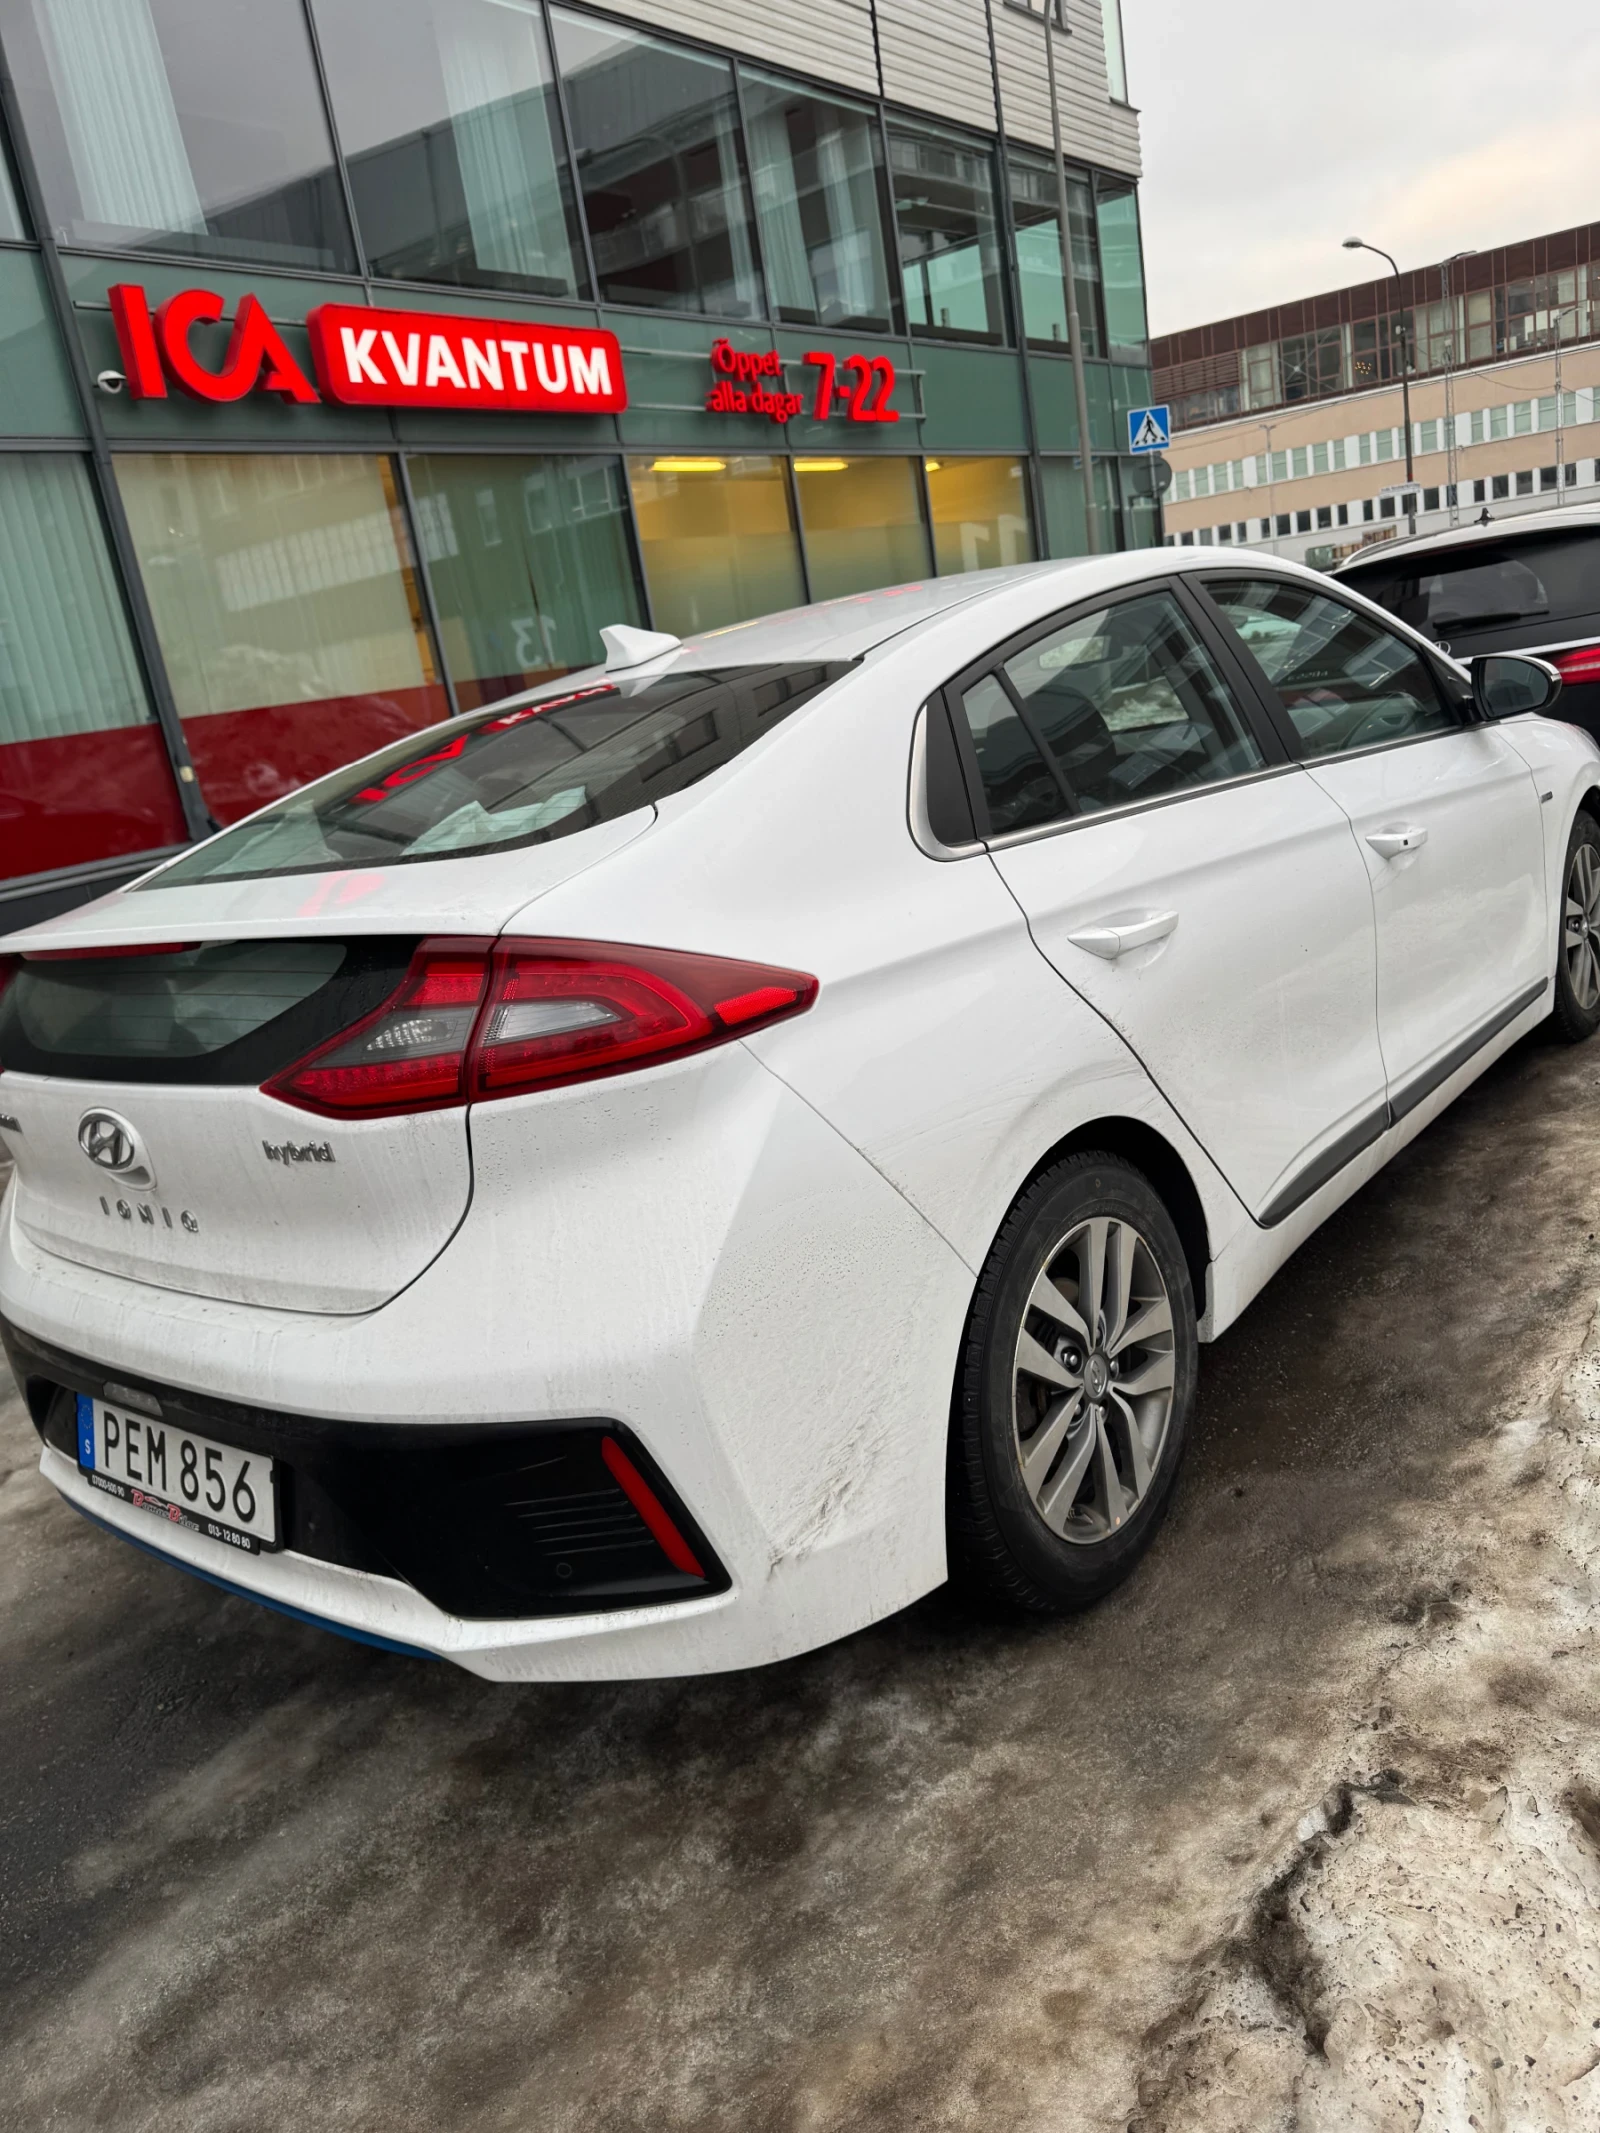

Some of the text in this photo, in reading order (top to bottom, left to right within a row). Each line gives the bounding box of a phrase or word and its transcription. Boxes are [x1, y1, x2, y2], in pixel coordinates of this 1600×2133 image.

[108, 284, 613, 403] ICA KVANTUM
[711, 338, 783, 382] Öppet
[706, 381, 804, 424] alla dagar
[803, 351, 900, 423] 7-22
[262, 1140, 336, 1165] hybrid
[100, 1196, 198, 1232] IONIQ
[84, 1439, 91, 1455] S
[103, 1411, 256, 1523] PEM 856
